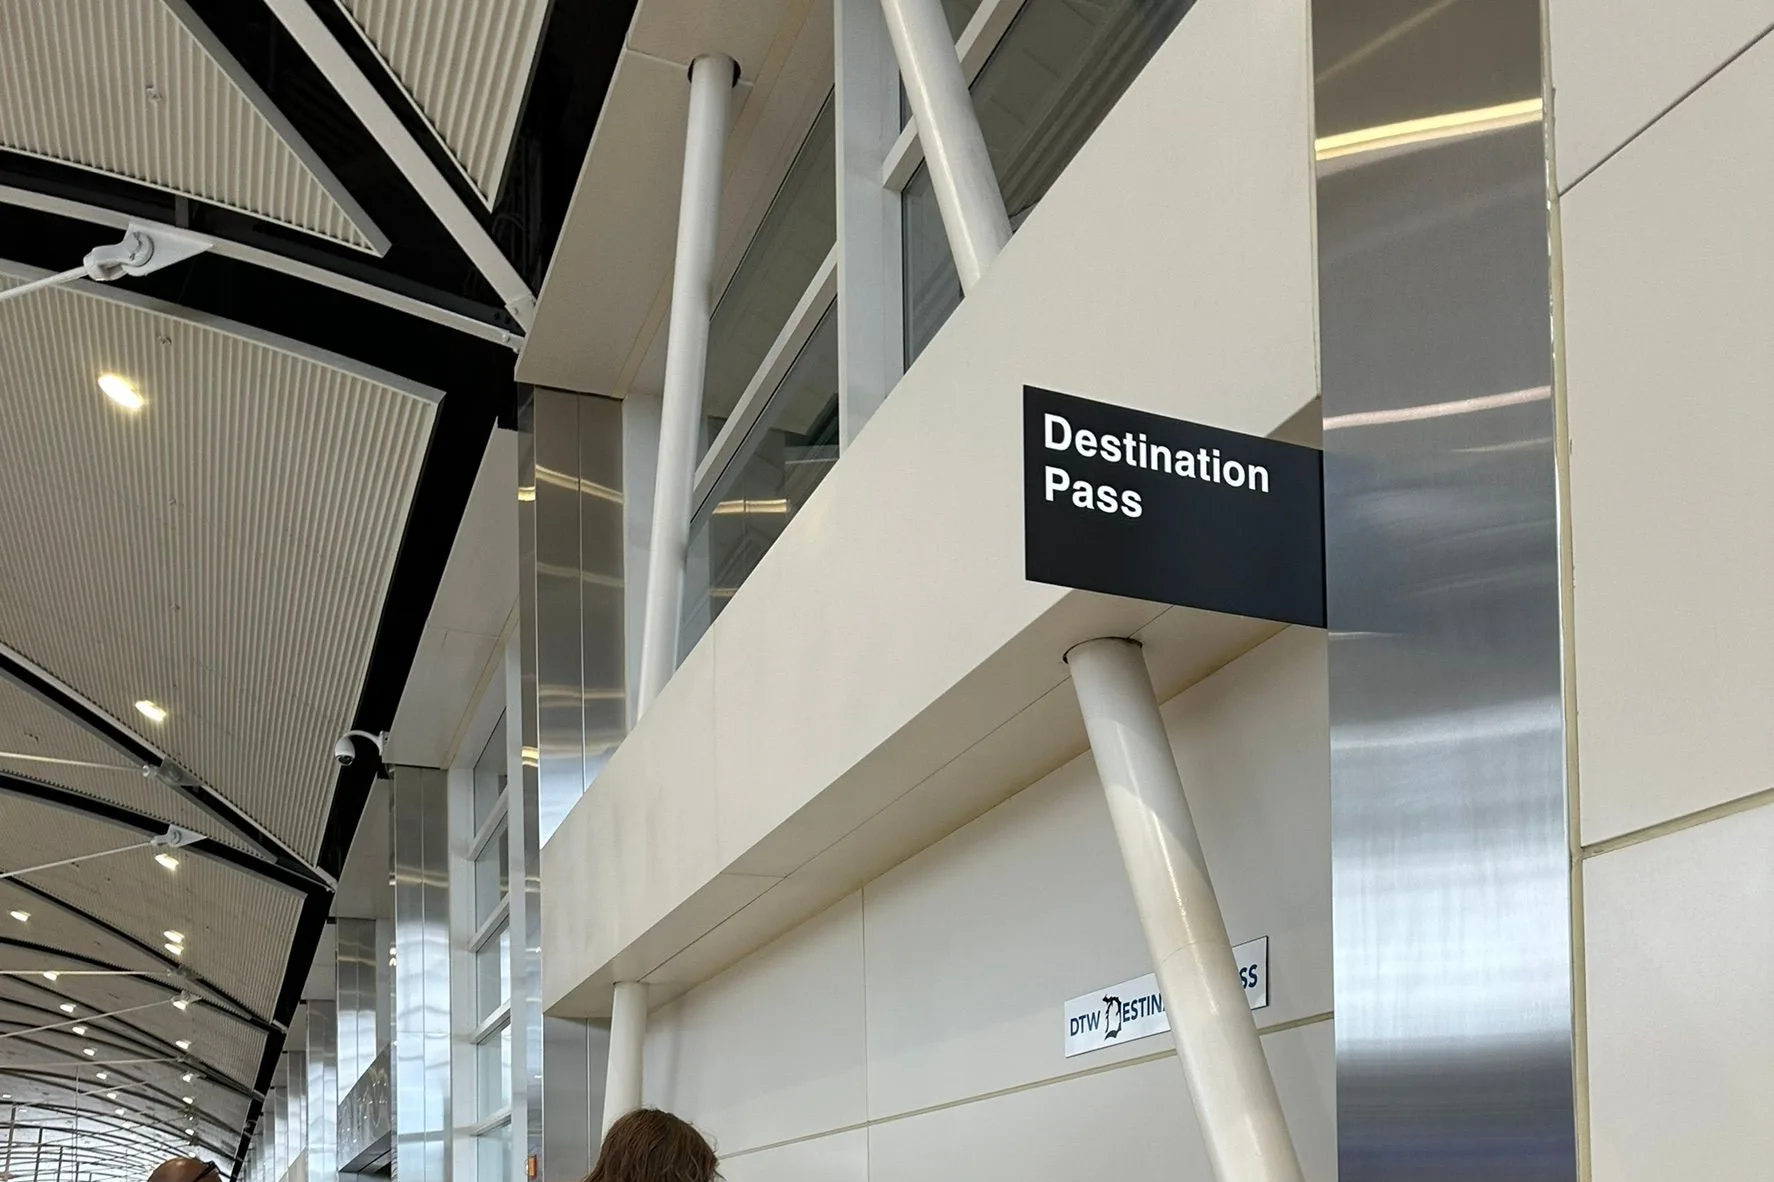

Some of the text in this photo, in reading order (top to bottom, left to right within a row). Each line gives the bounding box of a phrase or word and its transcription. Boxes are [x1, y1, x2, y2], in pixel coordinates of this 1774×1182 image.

[1044, 412, 1269, 493] Destination
[1044, 465, 1144, 518] Pass
[1070, 1010, 1101, 1037] DTW
